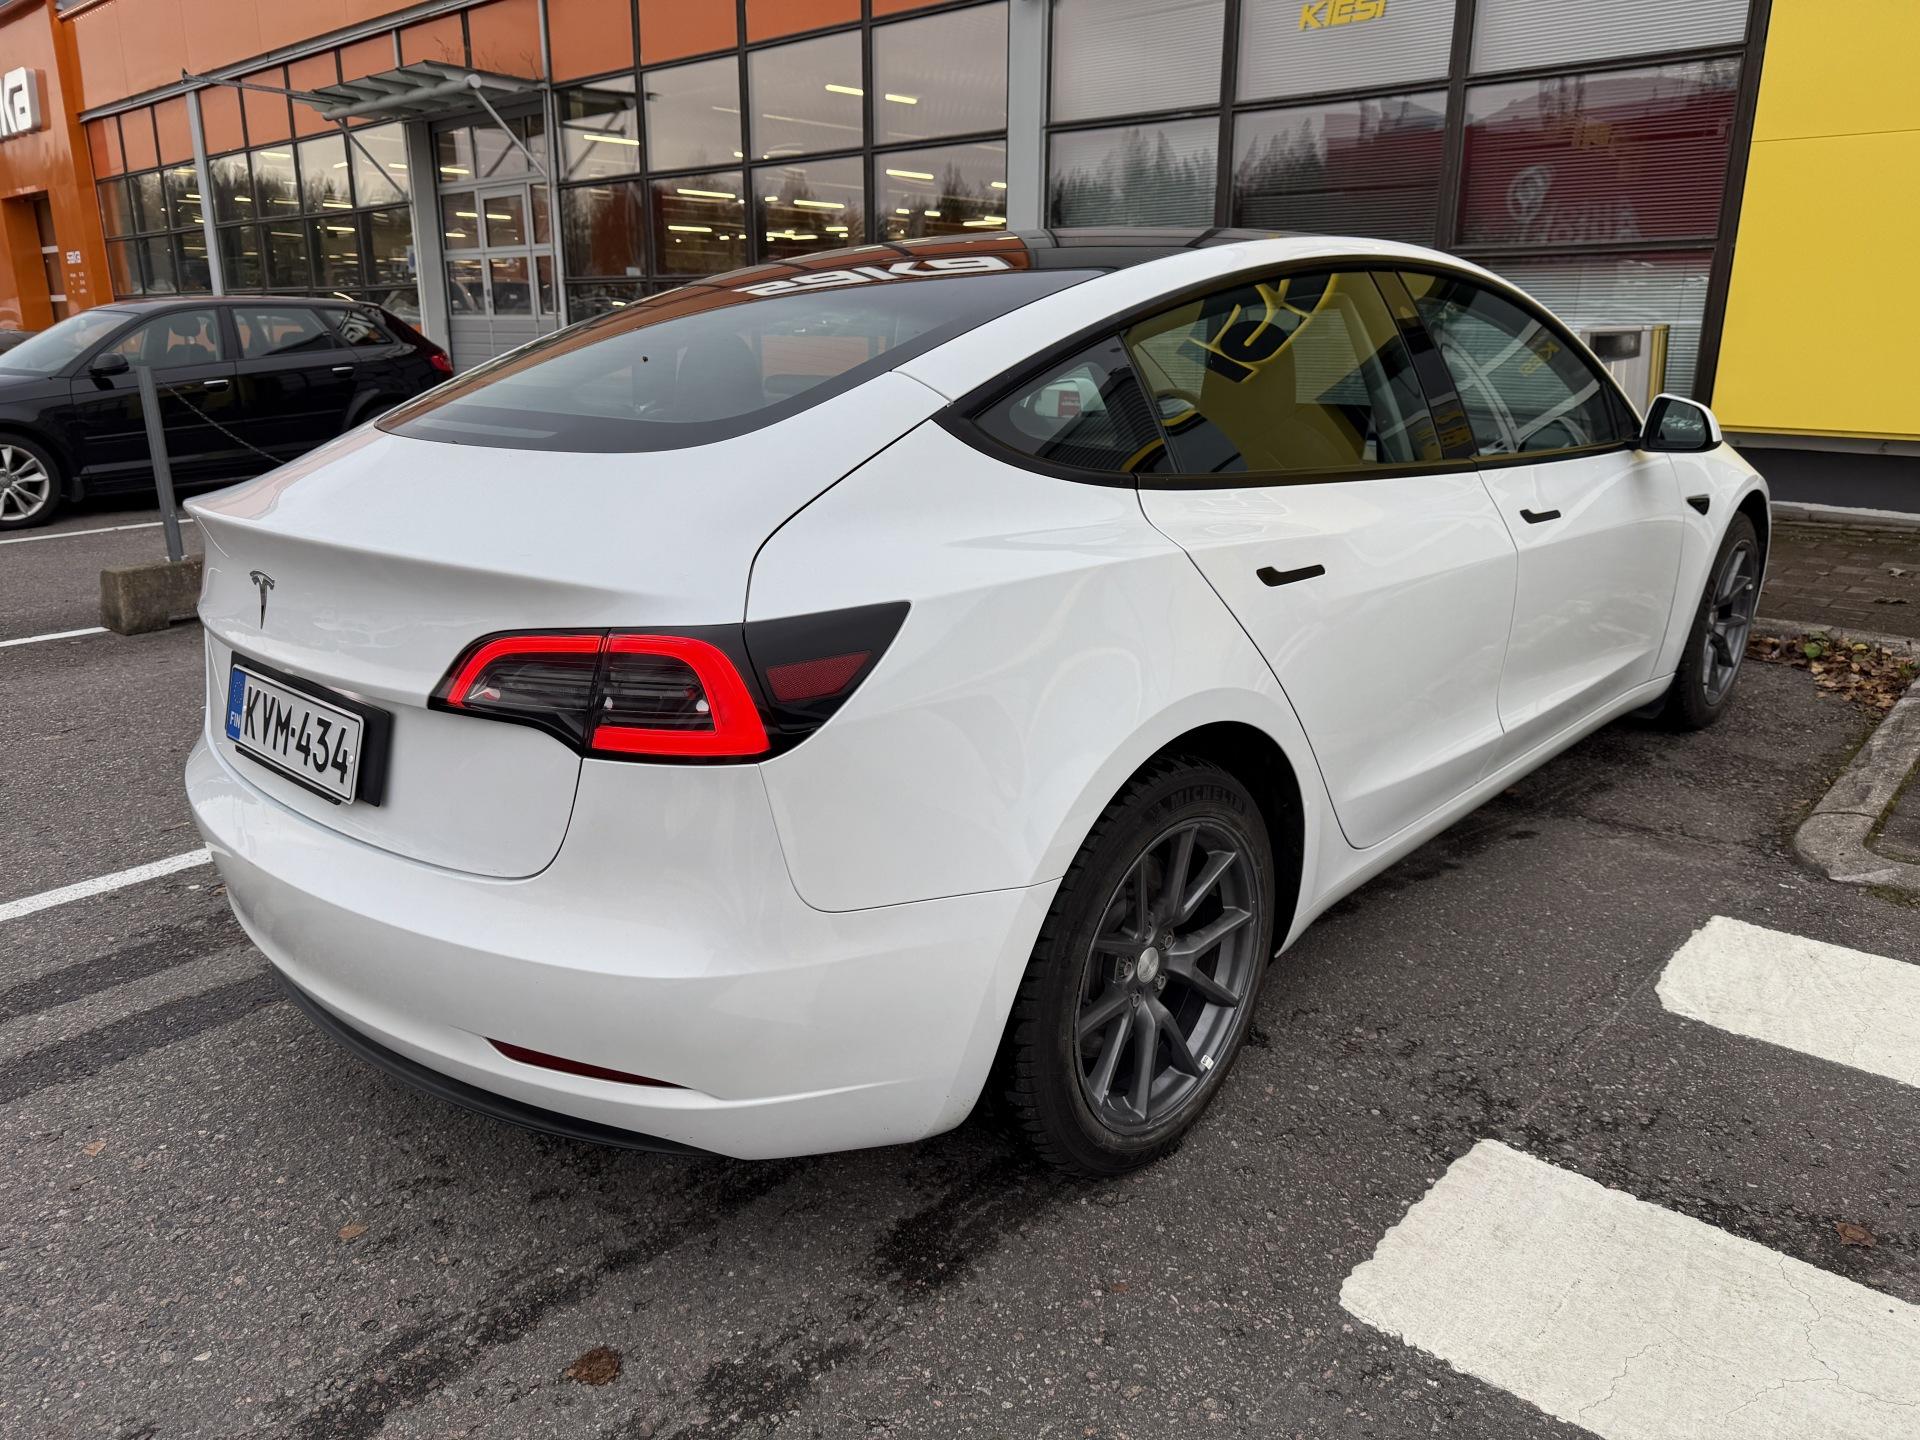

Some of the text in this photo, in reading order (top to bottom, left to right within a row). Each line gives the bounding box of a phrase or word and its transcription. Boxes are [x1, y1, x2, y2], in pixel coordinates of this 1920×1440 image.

[230, 711, 241, 727] FIN
[244, 685, 348, 784] KVM-434
[1171, 785, 1246, 814] MICHELIN
